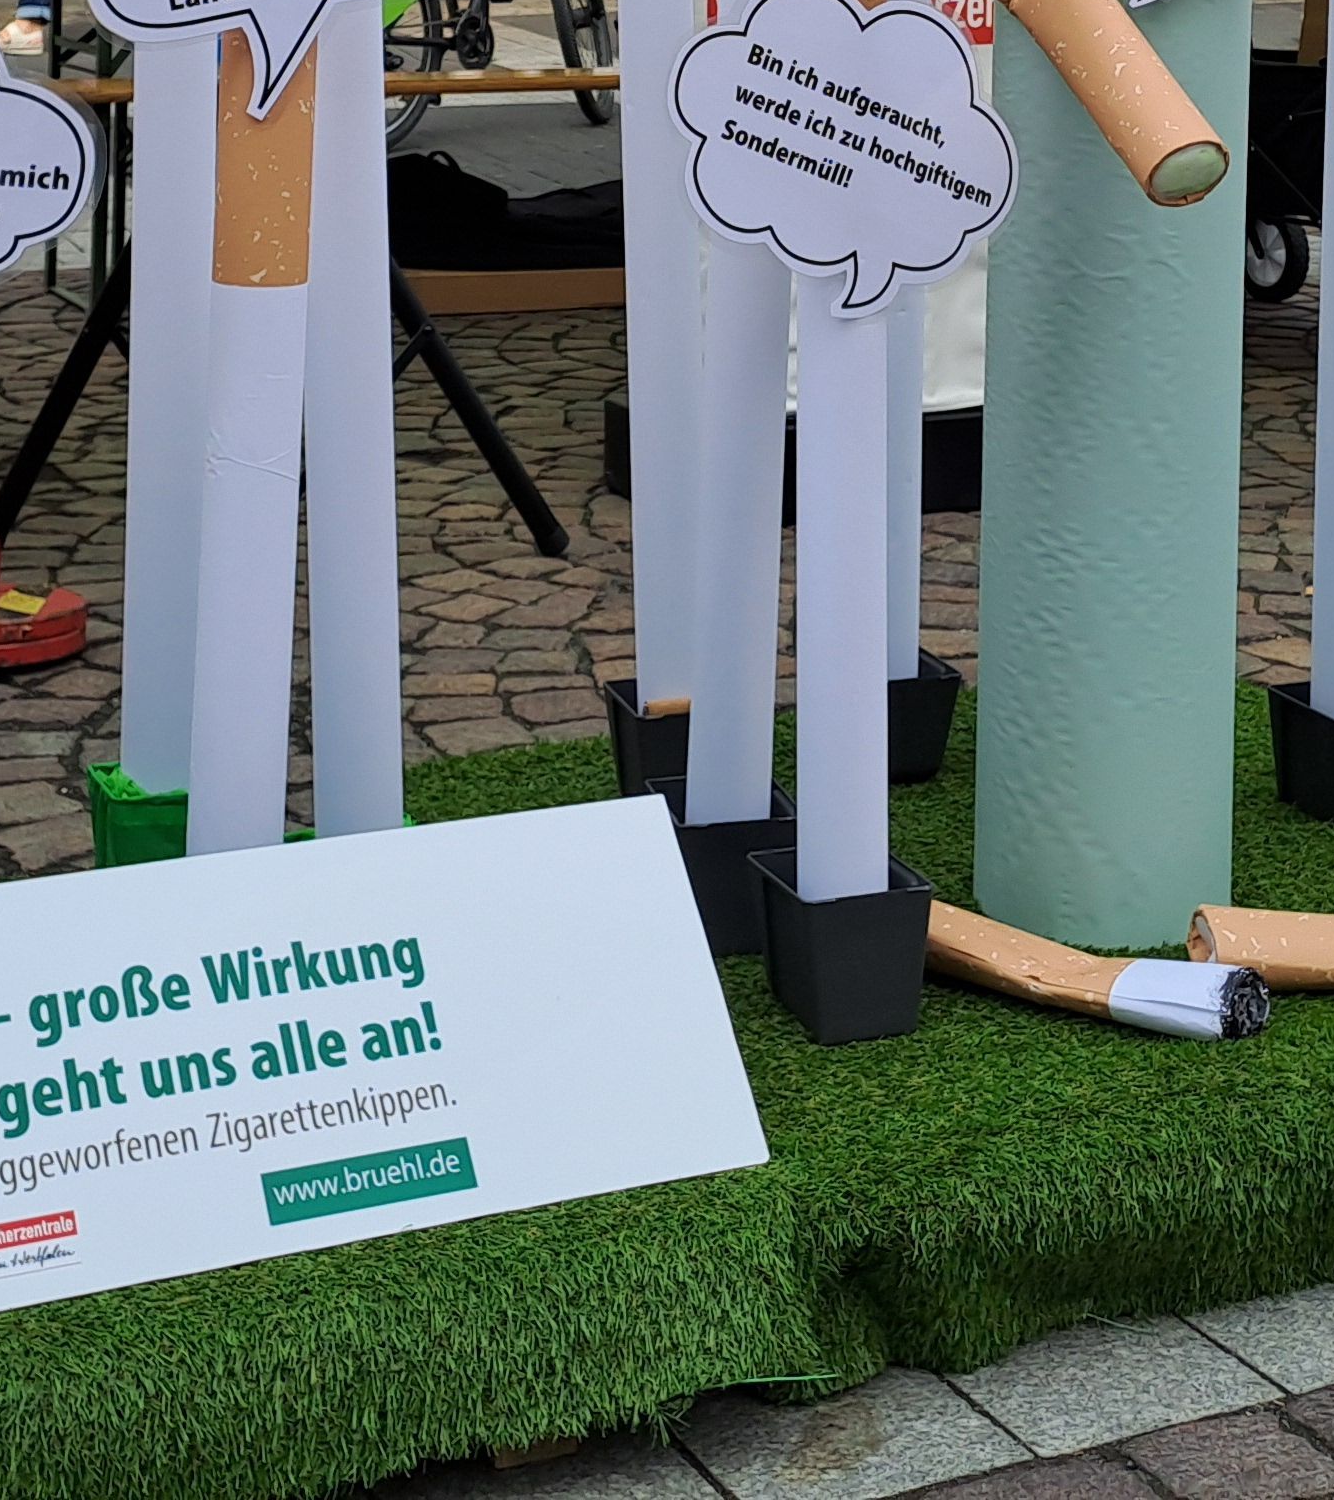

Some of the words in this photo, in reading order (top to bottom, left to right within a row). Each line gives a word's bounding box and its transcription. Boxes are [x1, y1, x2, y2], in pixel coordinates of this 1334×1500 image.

[28, 964, 190, 1047] große
[200, 937, 424, 1003] Wirkung
[139, 1047, 236, 1098] uns
[250, 1019, 347, 1080] alle
[359, 1000, 441, 1061] an!
[272, 1151, 461, 1206] www.bruehl.de
